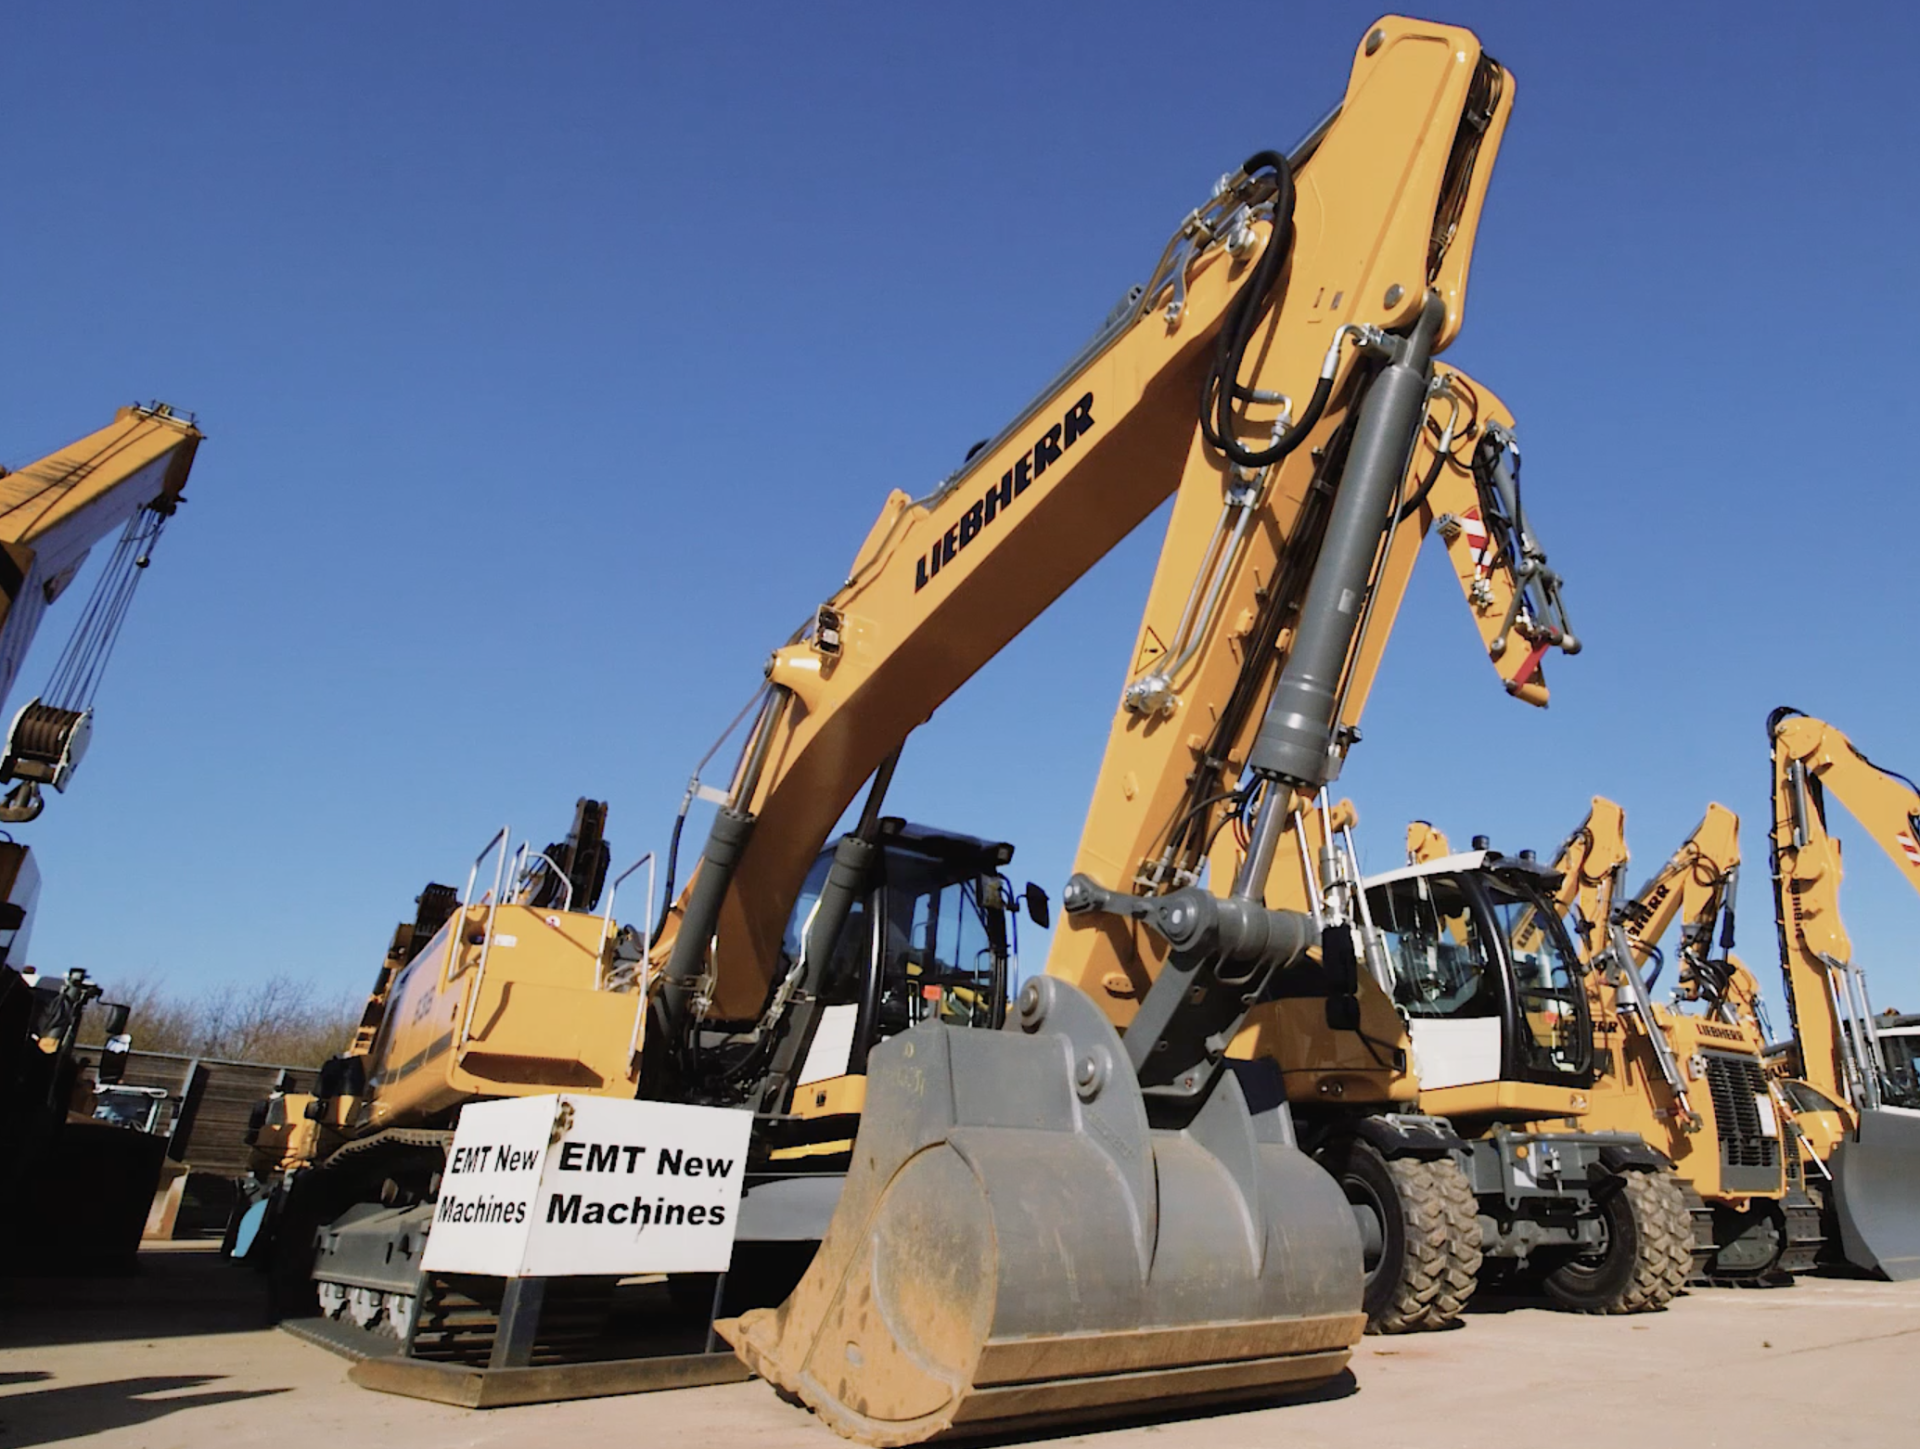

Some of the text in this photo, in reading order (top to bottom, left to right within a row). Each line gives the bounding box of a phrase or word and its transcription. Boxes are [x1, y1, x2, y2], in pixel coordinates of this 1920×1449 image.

[915, 391, 1095, 594] LIEBHERR
[1627, 884, 1670, 937] BHERR
[1695, 1023, 1746, 1042] LIEBHERR
[451, 1145, 540, 1175] EMT New
[559, 1141, 734, 1178] EMT New
[437, 1194, 527, 1224] Machines
[546, 1193, 726, 1226] Machines
